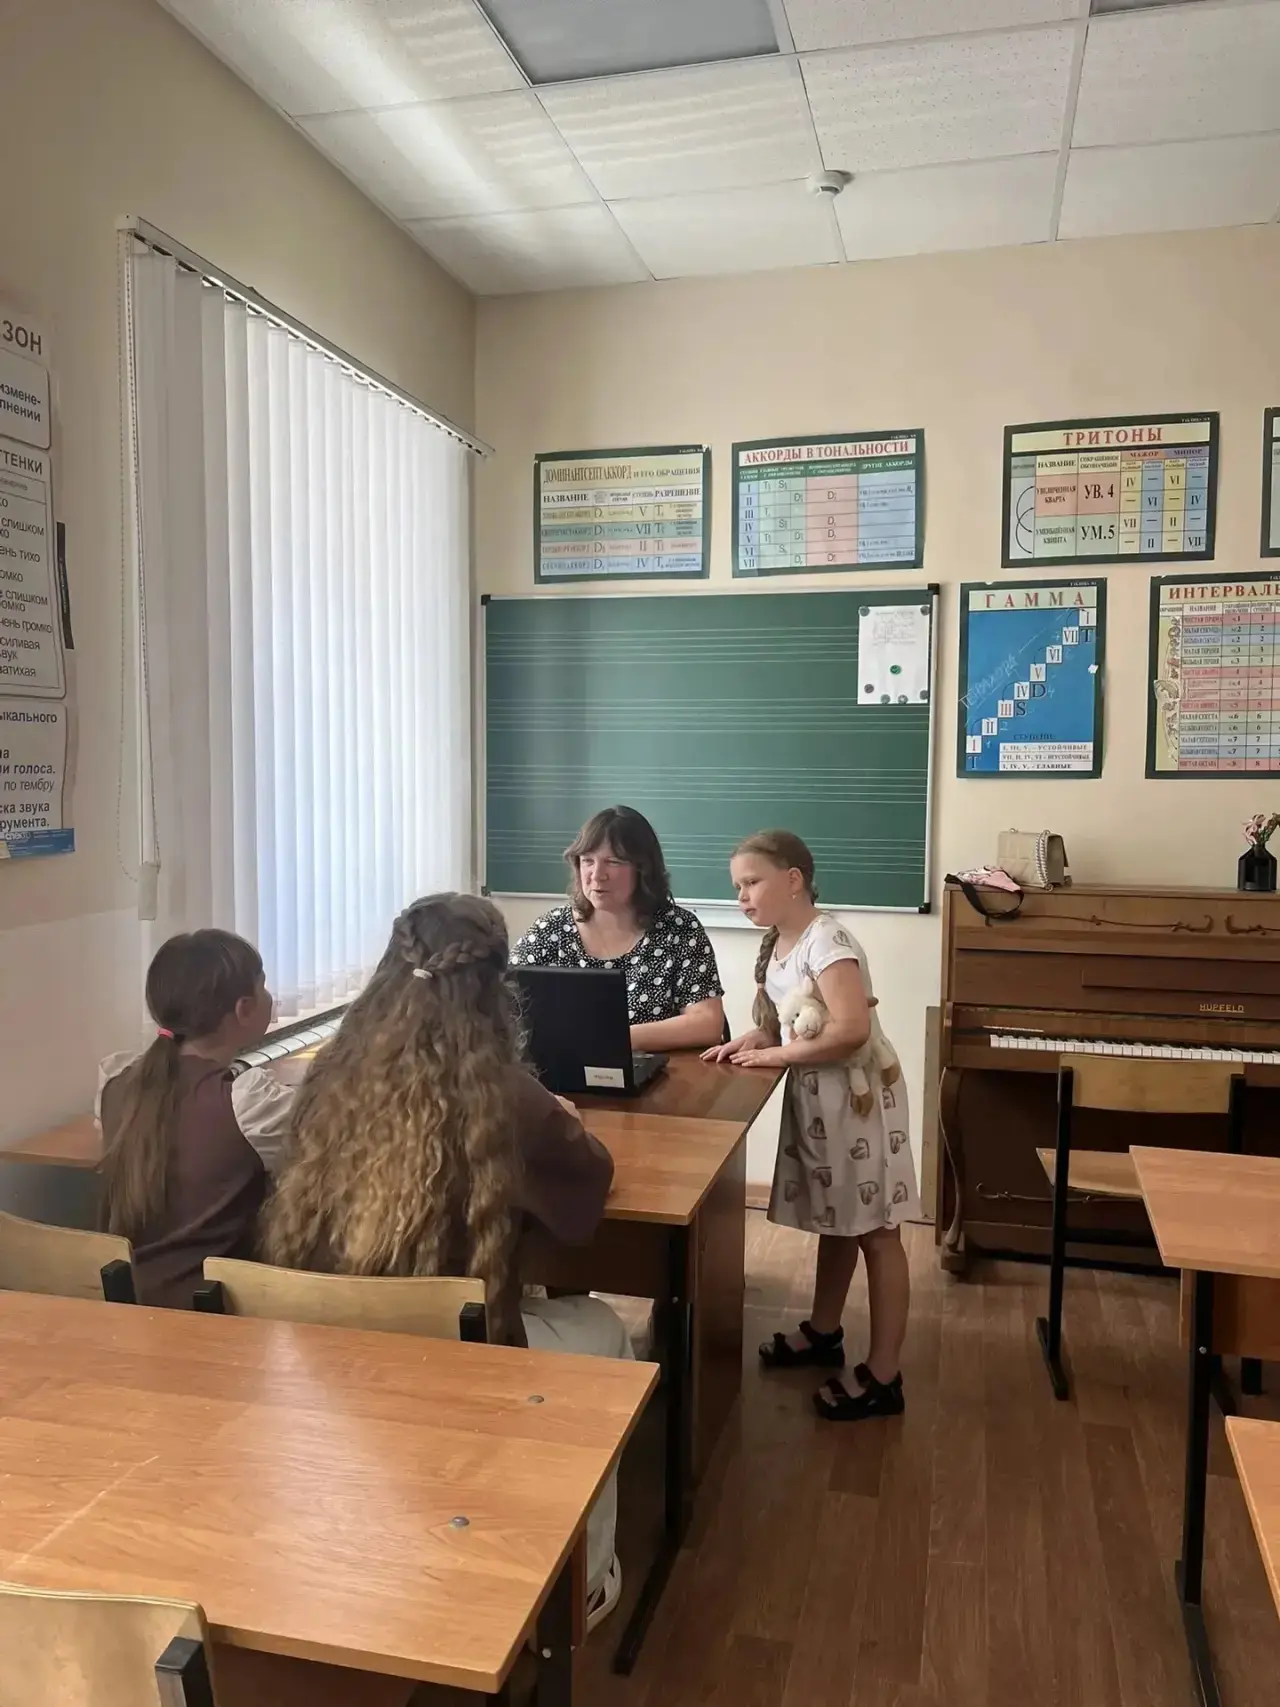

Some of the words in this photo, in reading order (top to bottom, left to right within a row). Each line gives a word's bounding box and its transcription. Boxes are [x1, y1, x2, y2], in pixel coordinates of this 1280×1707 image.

[1063, 428, 1163, 446] ТРИТОНЫ
[744, 447, 801, 464] АККОРДЫ
[807, 448, 813, 458] В
[814, 440, 909, 458] ТОНАЛЬНОСТИ
[0, 449, 42, 475] ТЕНКИ
[1037, 460, 1077, 469] НАЗВАНИЕ
[1126, 477, 1136, 487] IV
[1170, 475, 1180, 485] VI
[1084, 483, 1104, 500] УВ.
[1107, 483, 1114, 498] 4
[543, 493, 589, 504] НАЗВАНИЕ
[1148, 496, 1157, 506] VI
[1191, 495, 1201, 505] IV
[1, 517, 44, 536] слишком
[636, 523, 651, 534] VII
[1123, 518, 1137, 528] VII
[1188, 536, 1201, 546] VII
[19, 549, 40, 562] тихо
[5, 590, 48, 606] слишком
[985, 590, 1084, 608] ГАММА
[0, 600, 25, 612] омко
[22, 621, 52, 633] громко
[1063, 629, 1078, 643] VII
[1048, 648, 1060, 661] VI
[1016, 685, 1028, 698] IV
[1000, 703, 1012, 716] III
[14, 764, 55, 774] голоса.
[4, 780, 16, 791] по
[20, 778, 54, 793] тембру
[19, 802, 50, 815] звука
[1199, 1003, 1245, 1013] HUPFELD
